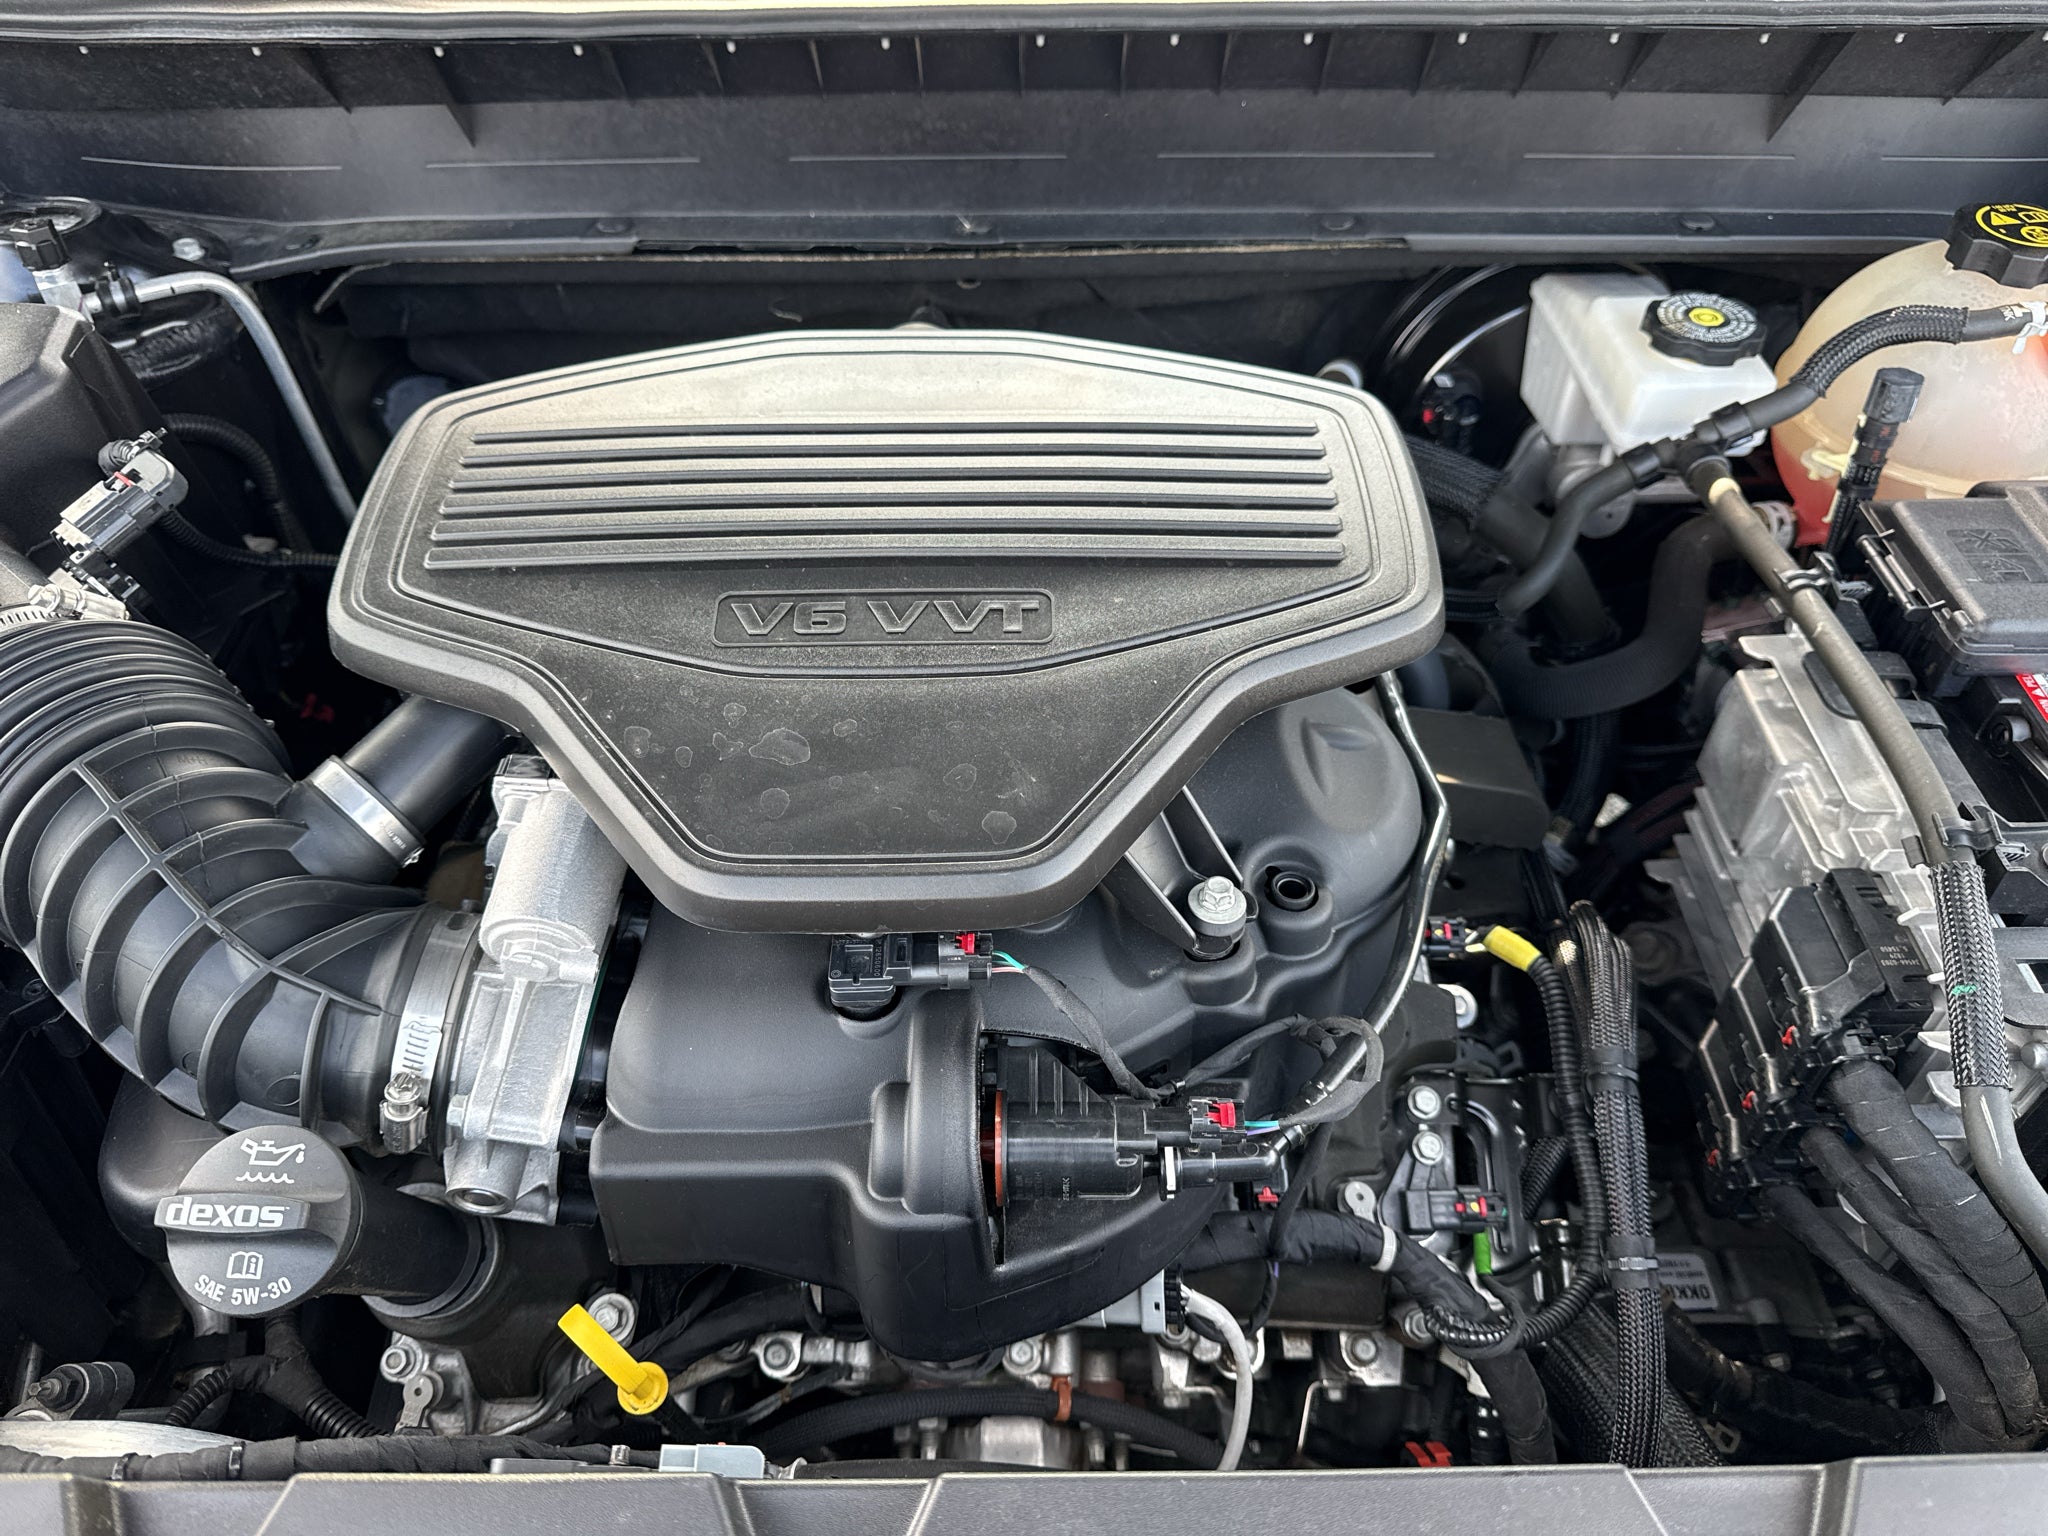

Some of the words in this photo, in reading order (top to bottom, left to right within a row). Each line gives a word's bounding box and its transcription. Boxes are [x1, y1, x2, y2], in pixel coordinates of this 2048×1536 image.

[731, 601, 847, 635] V6
[867, 599, 1040, 633] VVT
[165, 1197, 286, 1228] dexos
[194, 1274, 226, 1303] SAE
[231, 1276, 292, 1306] 5W-30
